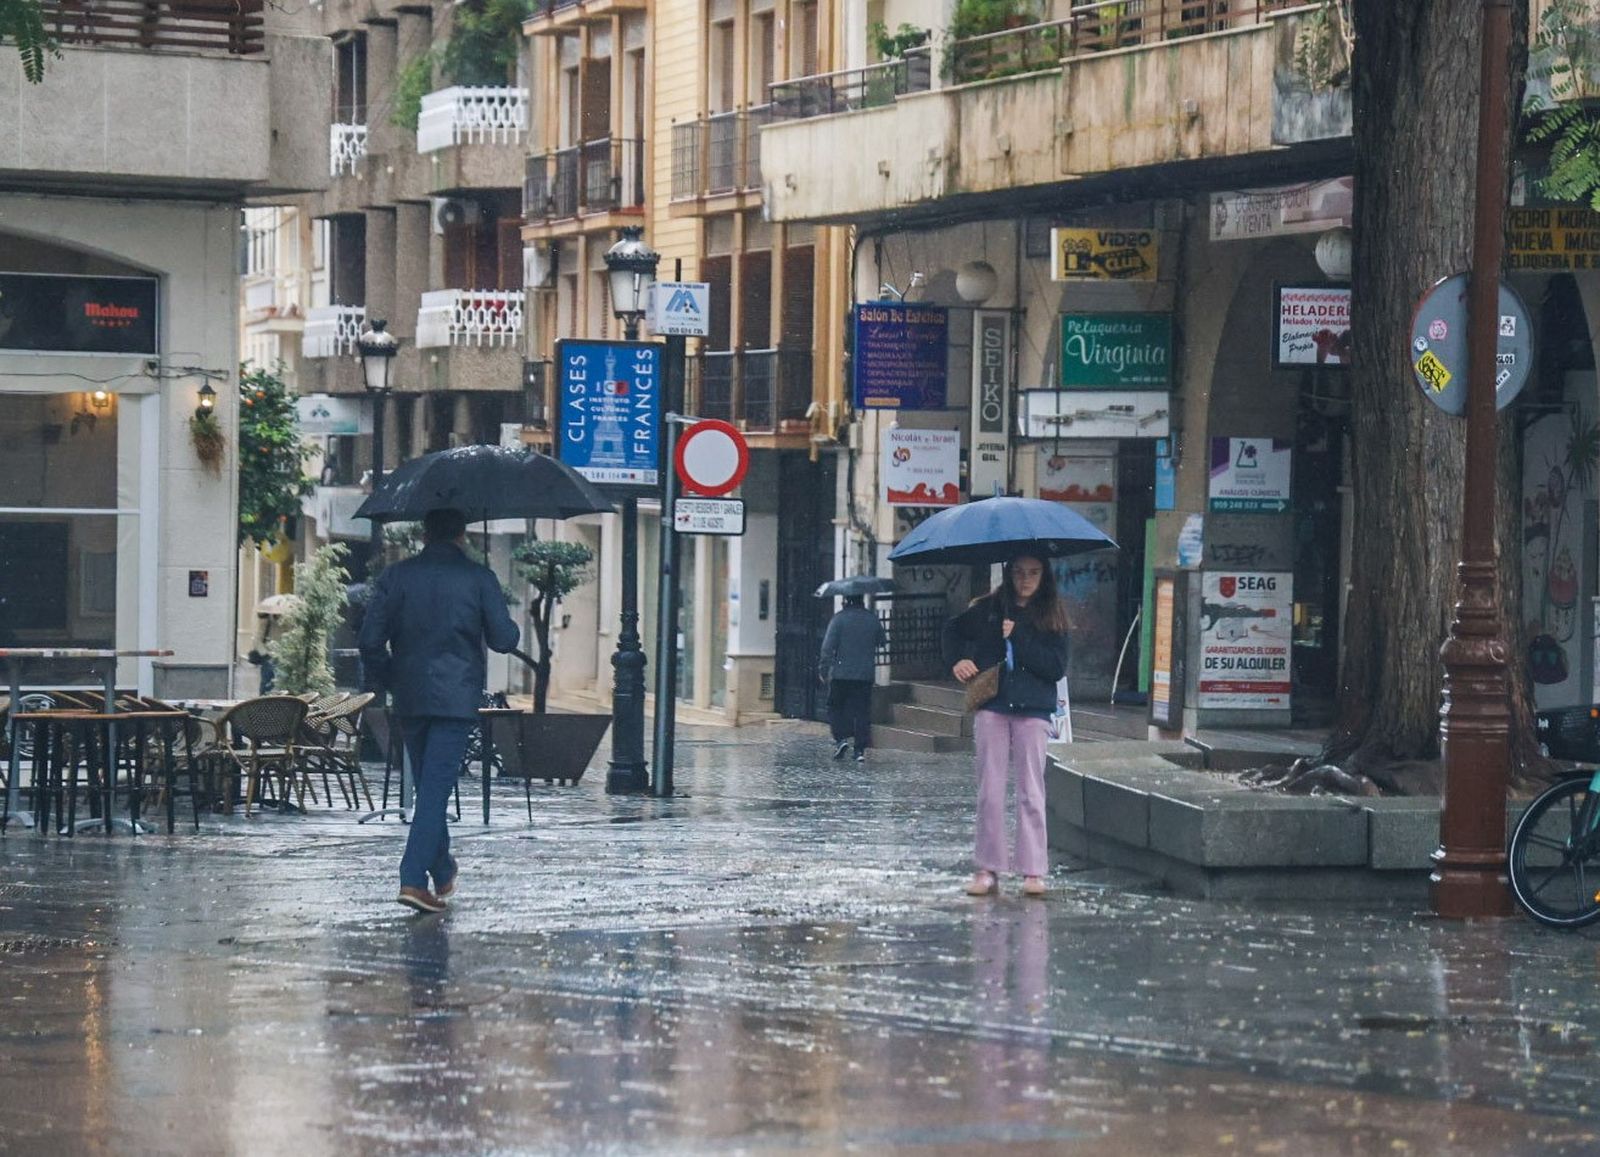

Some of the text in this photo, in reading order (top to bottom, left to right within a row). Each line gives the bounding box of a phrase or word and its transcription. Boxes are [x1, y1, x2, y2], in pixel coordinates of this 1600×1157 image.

[1244, 213, 1272, 233] VENTA
[85, 303, 139, 317] Mahou
[1065, 334, 1166, 373] Virginia
[982, 327, 1001, 421] SEIKO
[568, 355, 586, 442] CLASES
[633, 348, 653, 454] FRANCÉS
[1238, 576, 1276, 590] SEAG
[1205, 646, 1255, 654] GARANTIZAMOS
[1205, 657, 1286, 670] DE SU ALQUILER
